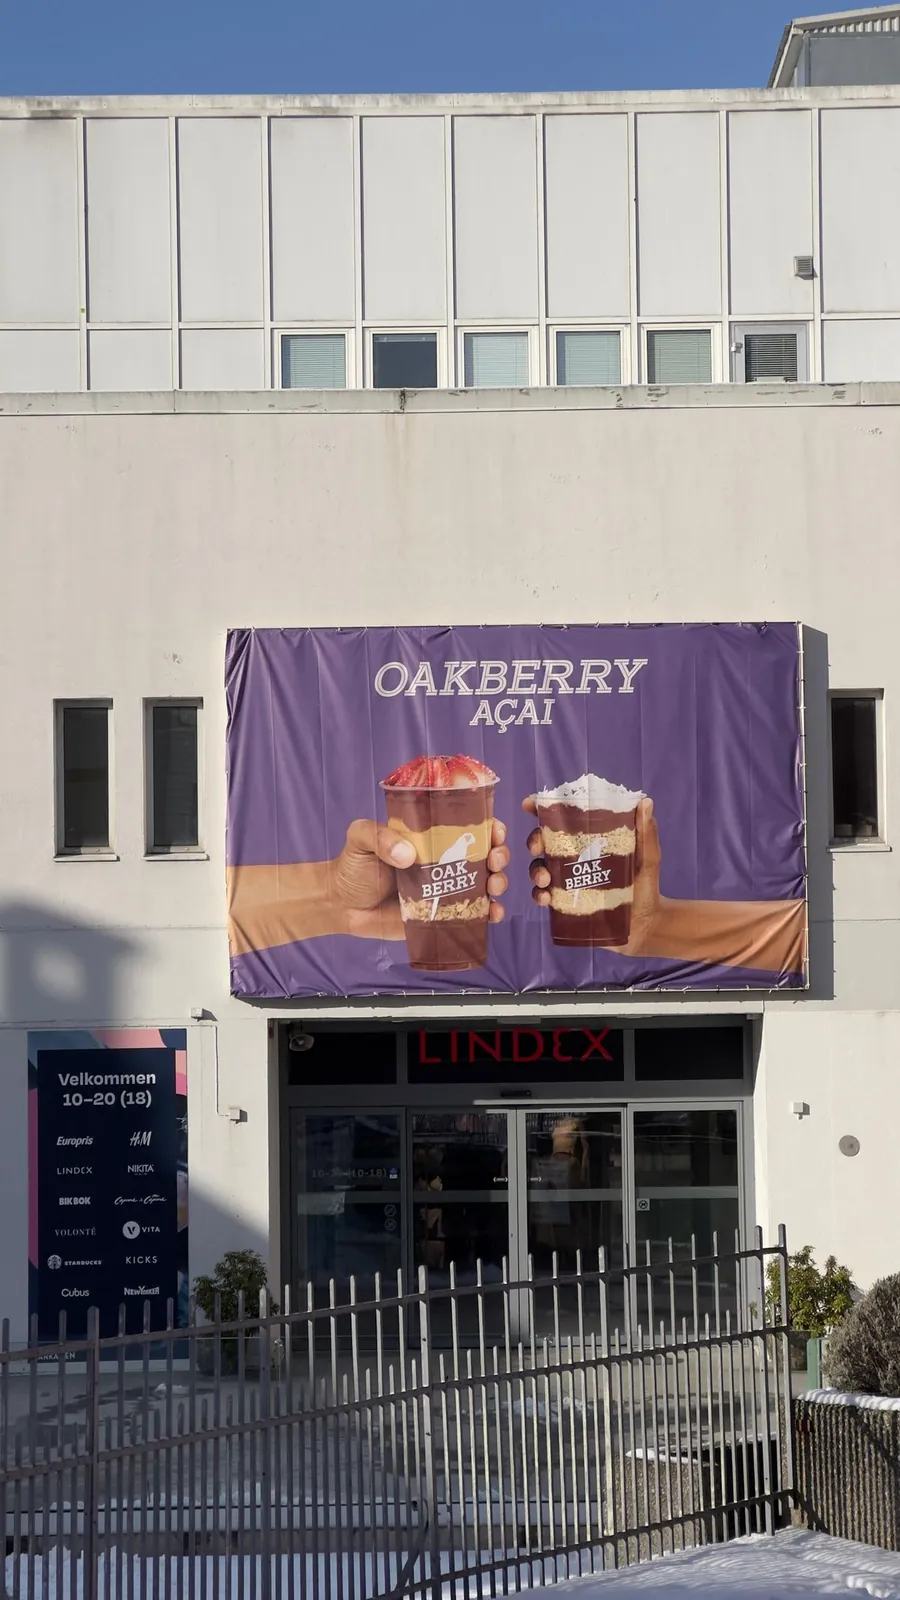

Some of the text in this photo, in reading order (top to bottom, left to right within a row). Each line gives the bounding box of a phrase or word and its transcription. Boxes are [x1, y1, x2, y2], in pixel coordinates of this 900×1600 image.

[374, 658, 648, 697] OAKBERRY
[469, 698, 555, 733] AÇAI
[430, 860, 468, 881] OAK
[572, 859, 602, 877] OAK
[421, 871, 478, 898] BERRY
[564, 869, 612, 890] BERRY
[418, 1026, 613, 1063] LINDEX
[58, 1072, 156, 1086] Velkommen
[120, 1089, 152, 1108] (18)
[56, 1136, 93, 1147] Europris
[56, 1167, 93, 1175] LINDEX
[127, 1164, 155, 1173] NIKITA
[54, 1226, 97, 1237] VOLONTÉ
[125, 1256, 158, 1265] KICKS
[61, 1288, 90, 1297] Cubus
